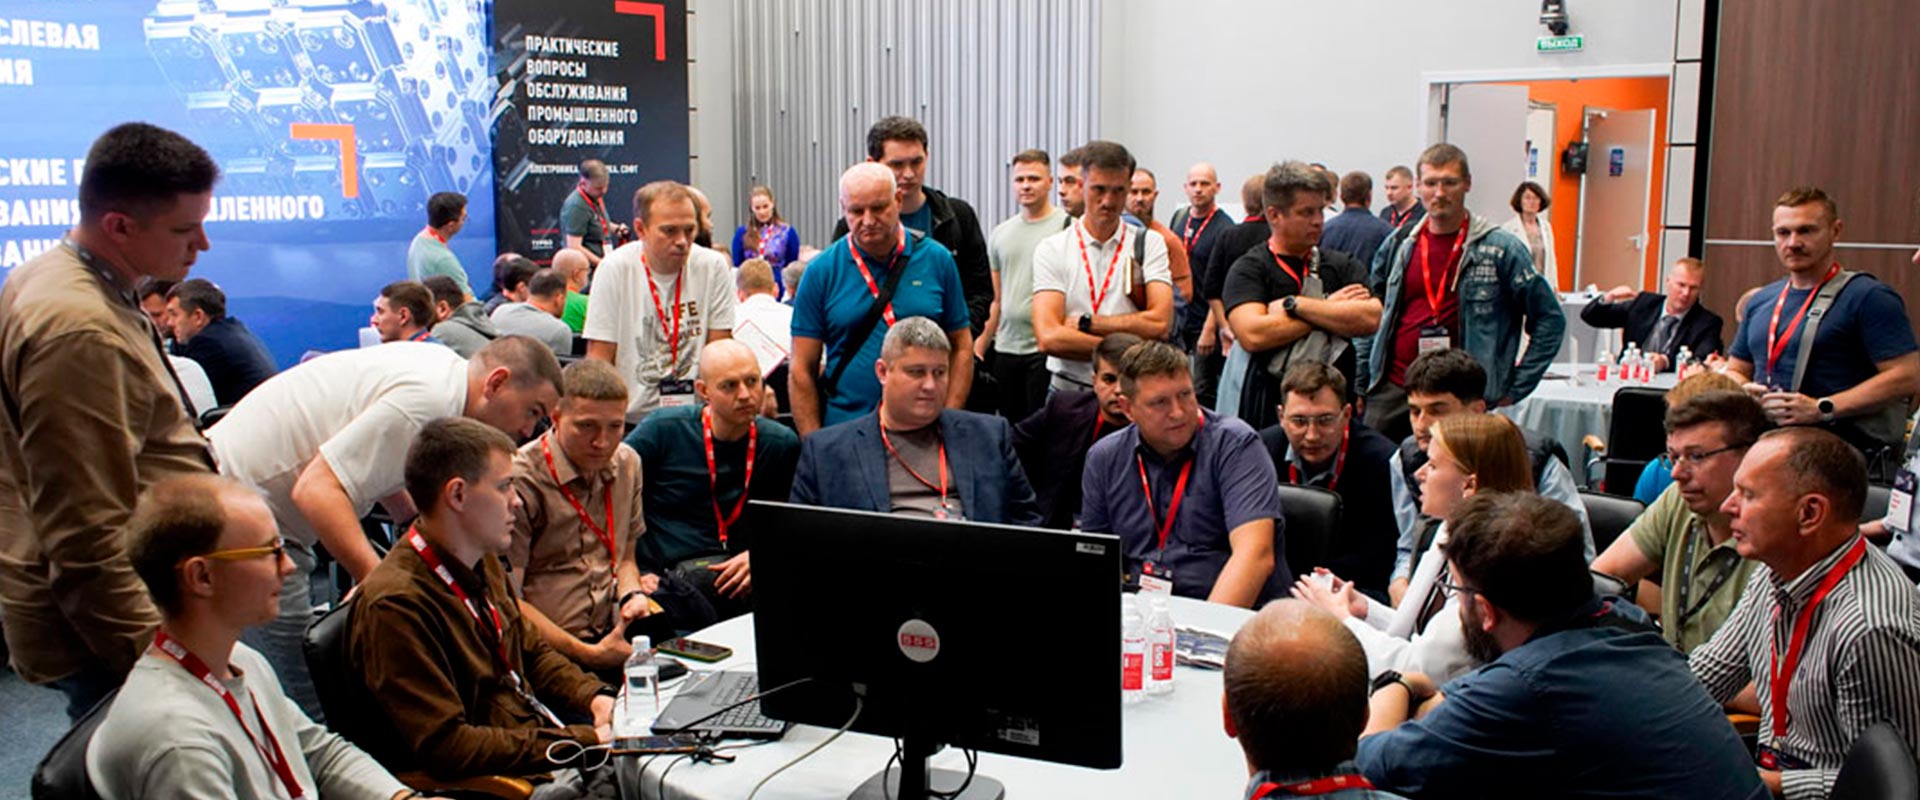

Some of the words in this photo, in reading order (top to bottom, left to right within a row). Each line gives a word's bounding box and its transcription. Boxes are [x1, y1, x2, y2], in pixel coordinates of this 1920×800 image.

[525, 35, 619, 57] ПРАКТИЧЕСКИЕ
[1541, 39, 1578, 49] ВЫХОД
[526, 59, 587, 77] ВОПРОСЫ
[527, 82, 627, 101] ОБСЛУЖИВАНИЯ
[528, 105, 638, 124] ПРОМЫШЛЕННОГО
[528, 128, 624, 147] ОБОРУДОВАНИЯ
